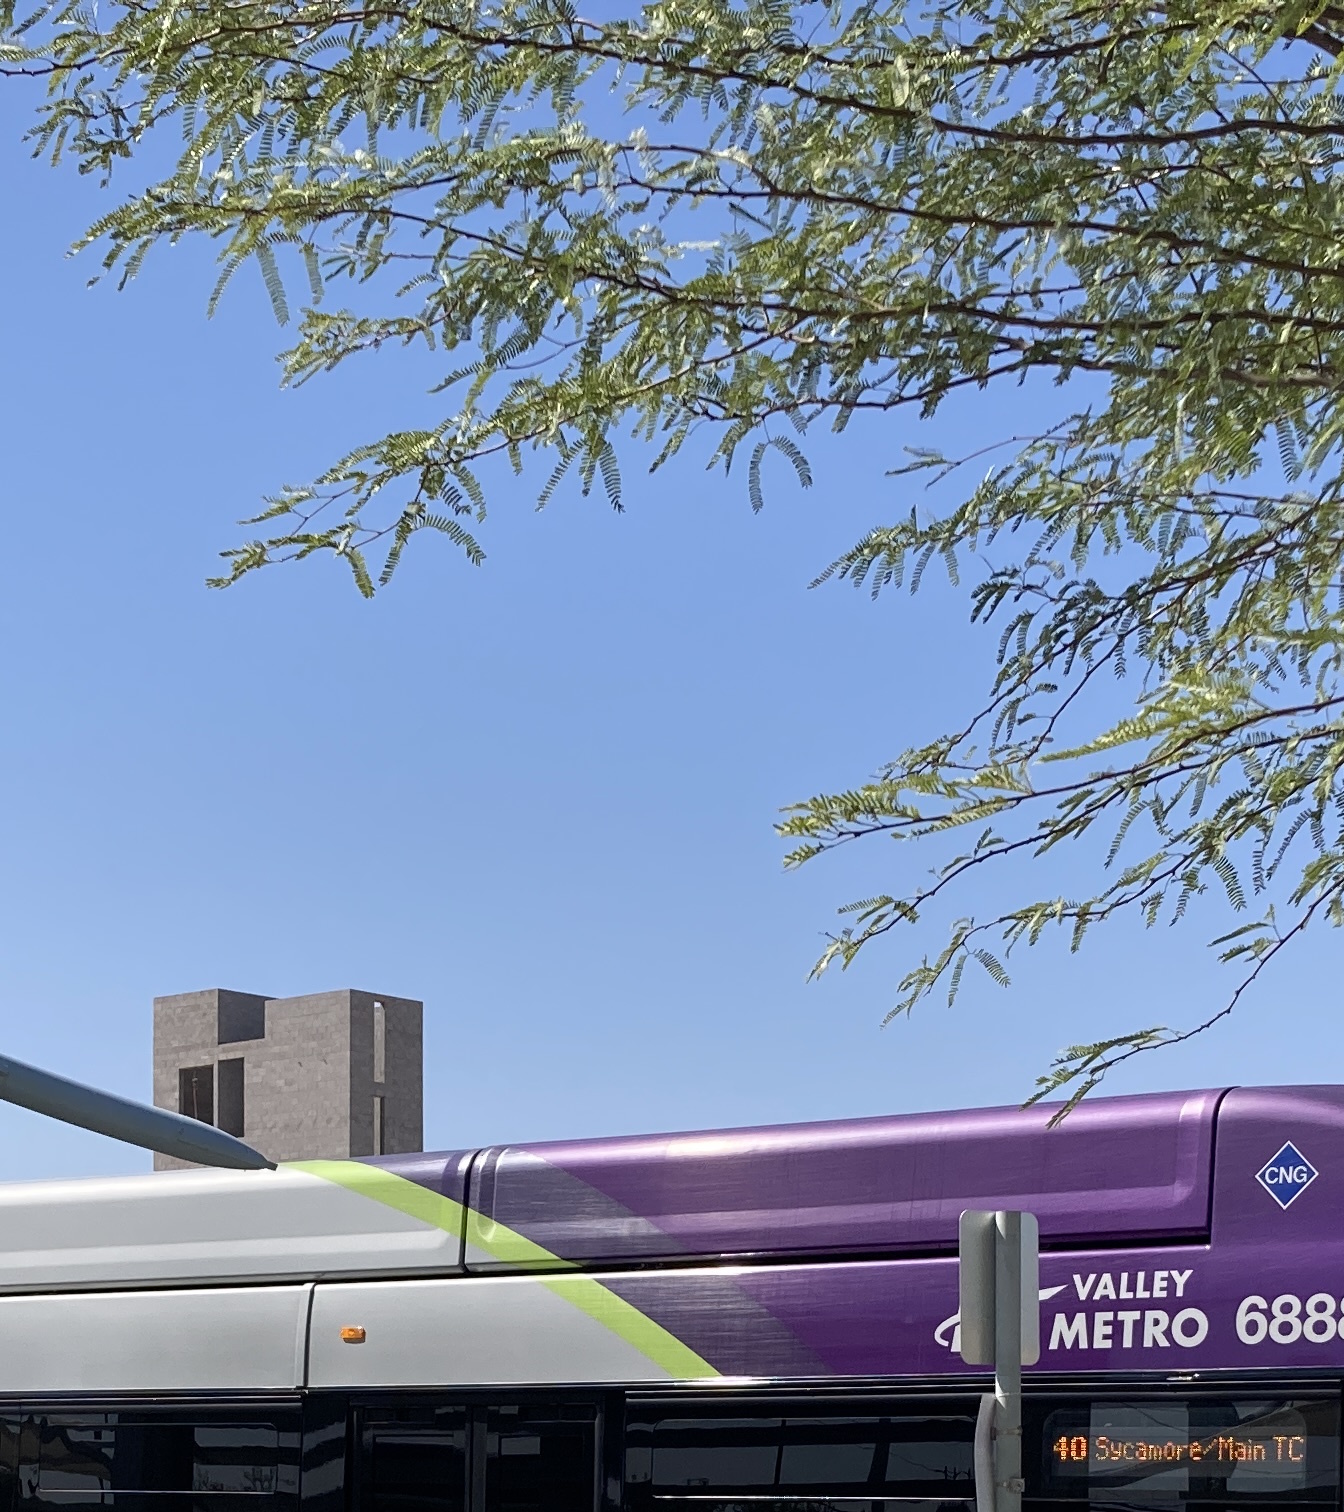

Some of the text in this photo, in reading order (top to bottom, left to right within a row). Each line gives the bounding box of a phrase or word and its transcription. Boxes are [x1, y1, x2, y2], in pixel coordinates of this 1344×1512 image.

[1264, 1165, 1308, 1185] CNG
[1072, 1269, 1194, 1301] VALLEY
[1048, 1307, 1209, 1350] METRO
[1053, 1435, 1304, 1462] 40 Sycamore/Main TC
